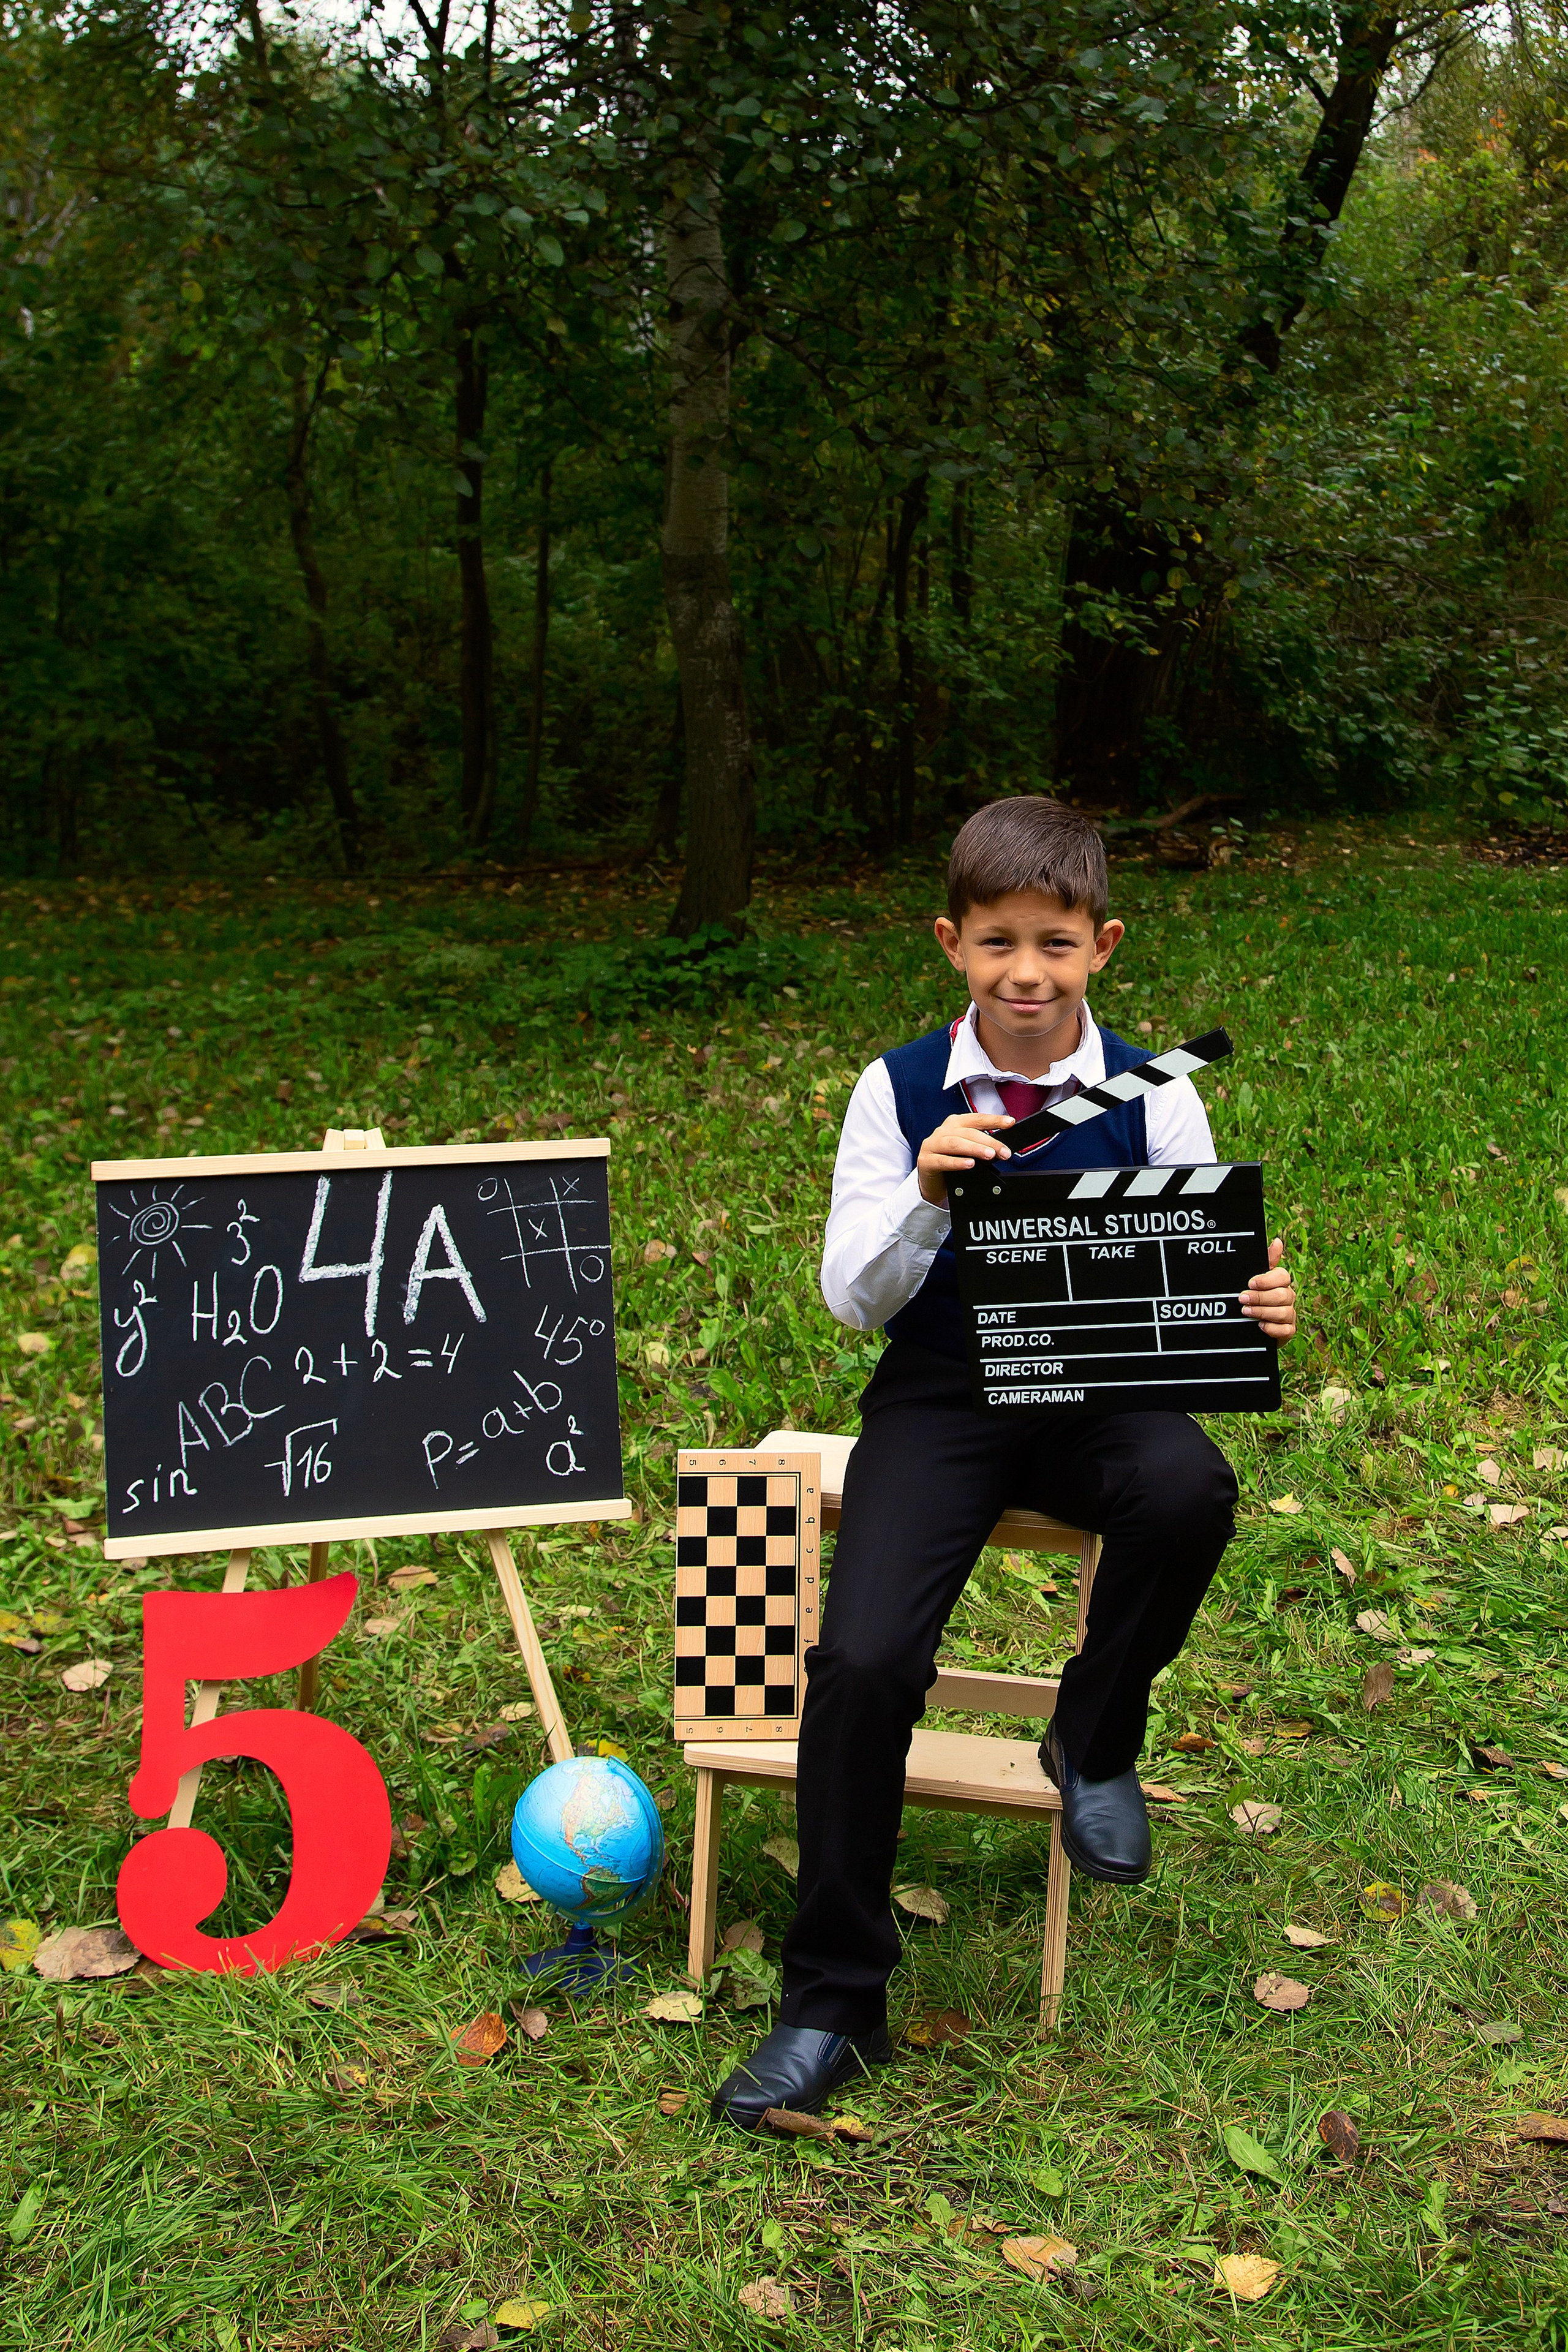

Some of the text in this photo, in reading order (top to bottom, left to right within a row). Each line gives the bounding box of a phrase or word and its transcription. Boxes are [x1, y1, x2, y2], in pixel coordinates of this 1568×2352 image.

[969, 1216, 1098, 1242] UNIVERSAL
[298, 1170, 488, 1338] 4A
[1088, 1245, 1136, 1259] TAKE
[1187, 1240, 1237, 1254] ROLL
[986, 1249, 1047, 1264] SCENE
[978, 1311, 1017, 1324] DATE
[1160, 1302, 1227, 1319] SOUND
[981, 1333, 1055, 1348] PROD.CO.
[985, 1362, 1064, 1377] DIRECTOR
[988, 1389, 1085, 1405] CAMERAMAN
[178, 1355, 287, 1469] ABC
[122, 1465, 198, 1515] sin
[116, 1570, 392, 1977] 5
